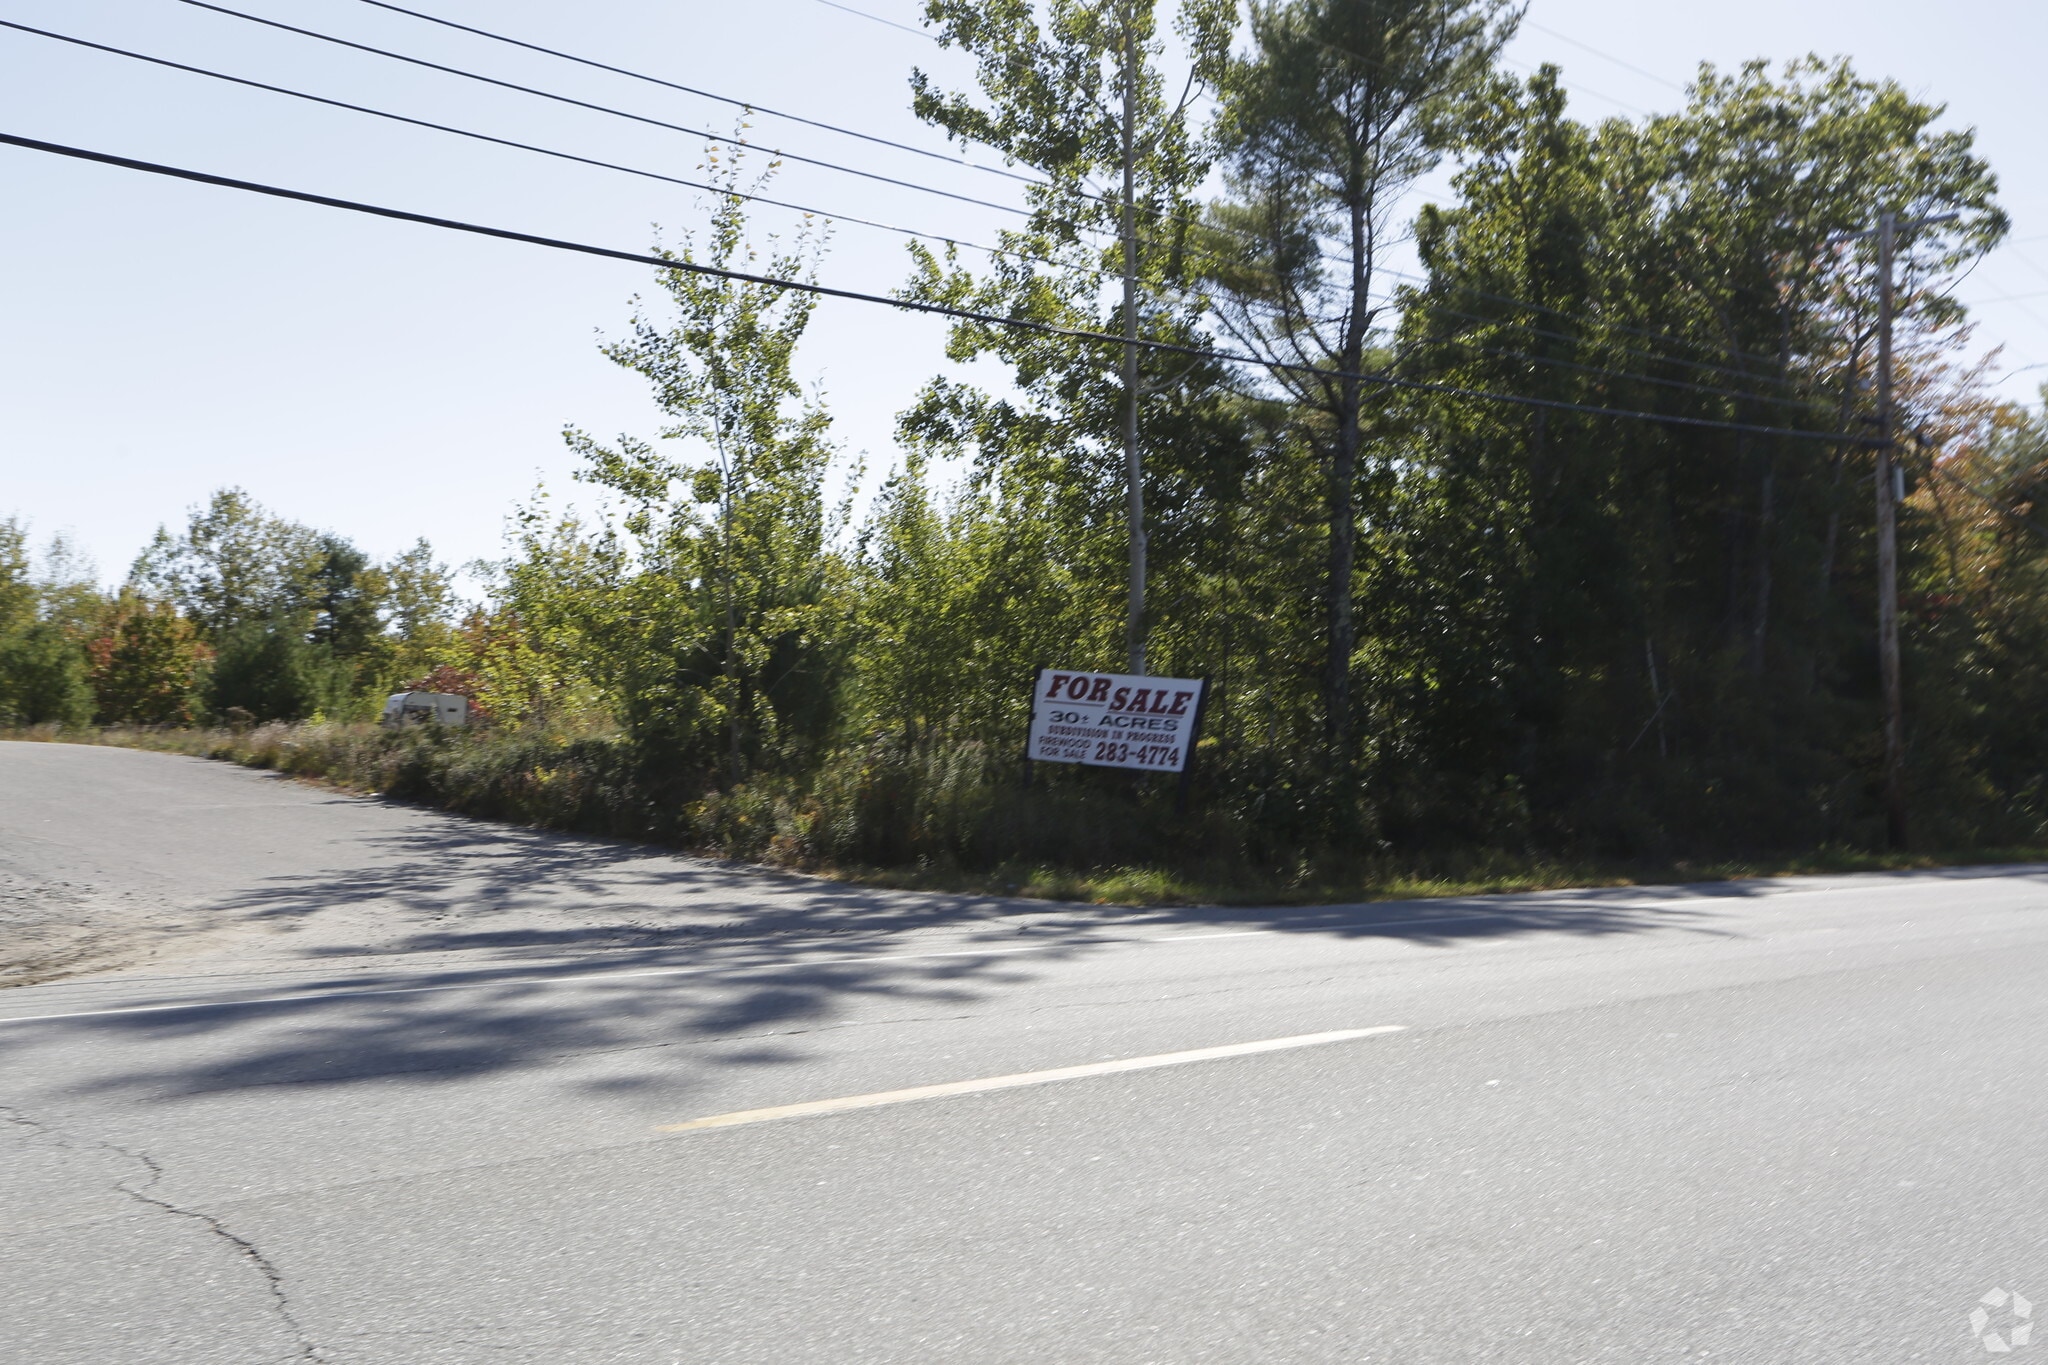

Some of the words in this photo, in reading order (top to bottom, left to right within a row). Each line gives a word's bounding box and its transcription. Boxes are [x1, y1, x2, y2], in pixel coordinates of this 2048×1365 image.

[1045, 674, 1113, 702] FOR
[1108, 687, 1194, 715] SALE
[1097, 715, 1179, 731] ACRES
[1038, 736, 1091, 749] FIREWOOD
[1048, 725, 1109, 739] SUBDIVISION
[1112, 731, 1123, 740] IN
[1126, 731, 1176, 744] PROGRESS
[1039, 746, 1060, 758] FOR
[1063, 748, 1087, 760] SALE
[1094, 741, 1180, 766] 283-4774
